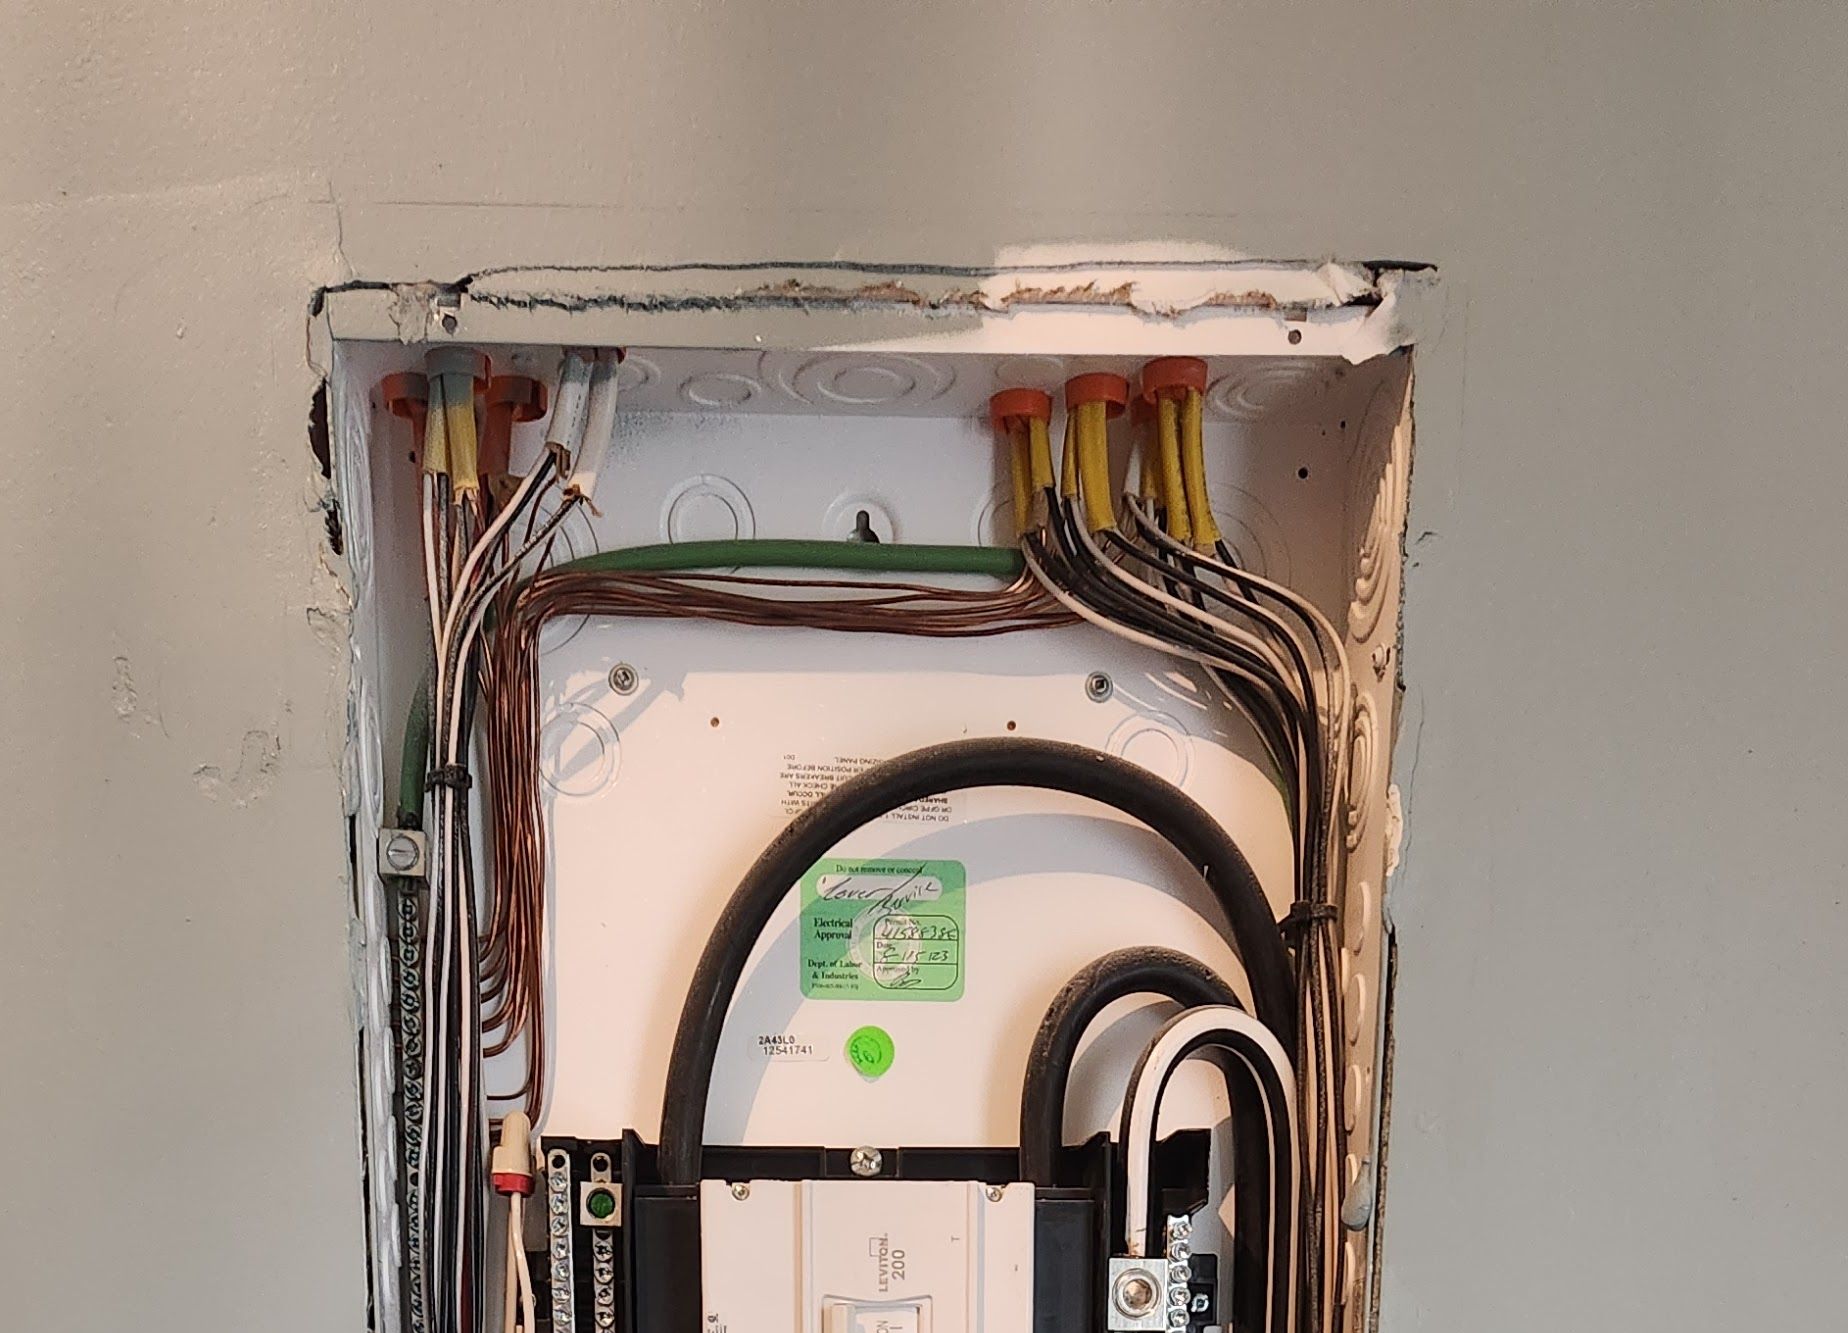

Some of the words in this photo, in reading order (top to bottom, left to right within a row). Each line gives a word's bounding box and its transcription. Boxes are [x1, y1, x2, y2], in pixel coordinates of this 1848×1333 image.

[813, 917, 853, 928] Electrical
[814, 929, 852, 941] Approval
[807, 959, 828, 969] Dept.
[830, 959, 838, 968] of
[840, 960, 863, 968] Labor
[811, 971, 819, 979] &
[821, 971, 859, 980] Industries
[763, 1045, 813, 1056] 12541741
[878, 1235, 889, 1292] LEVITON
[891, 1249, 906, 1280] 200
